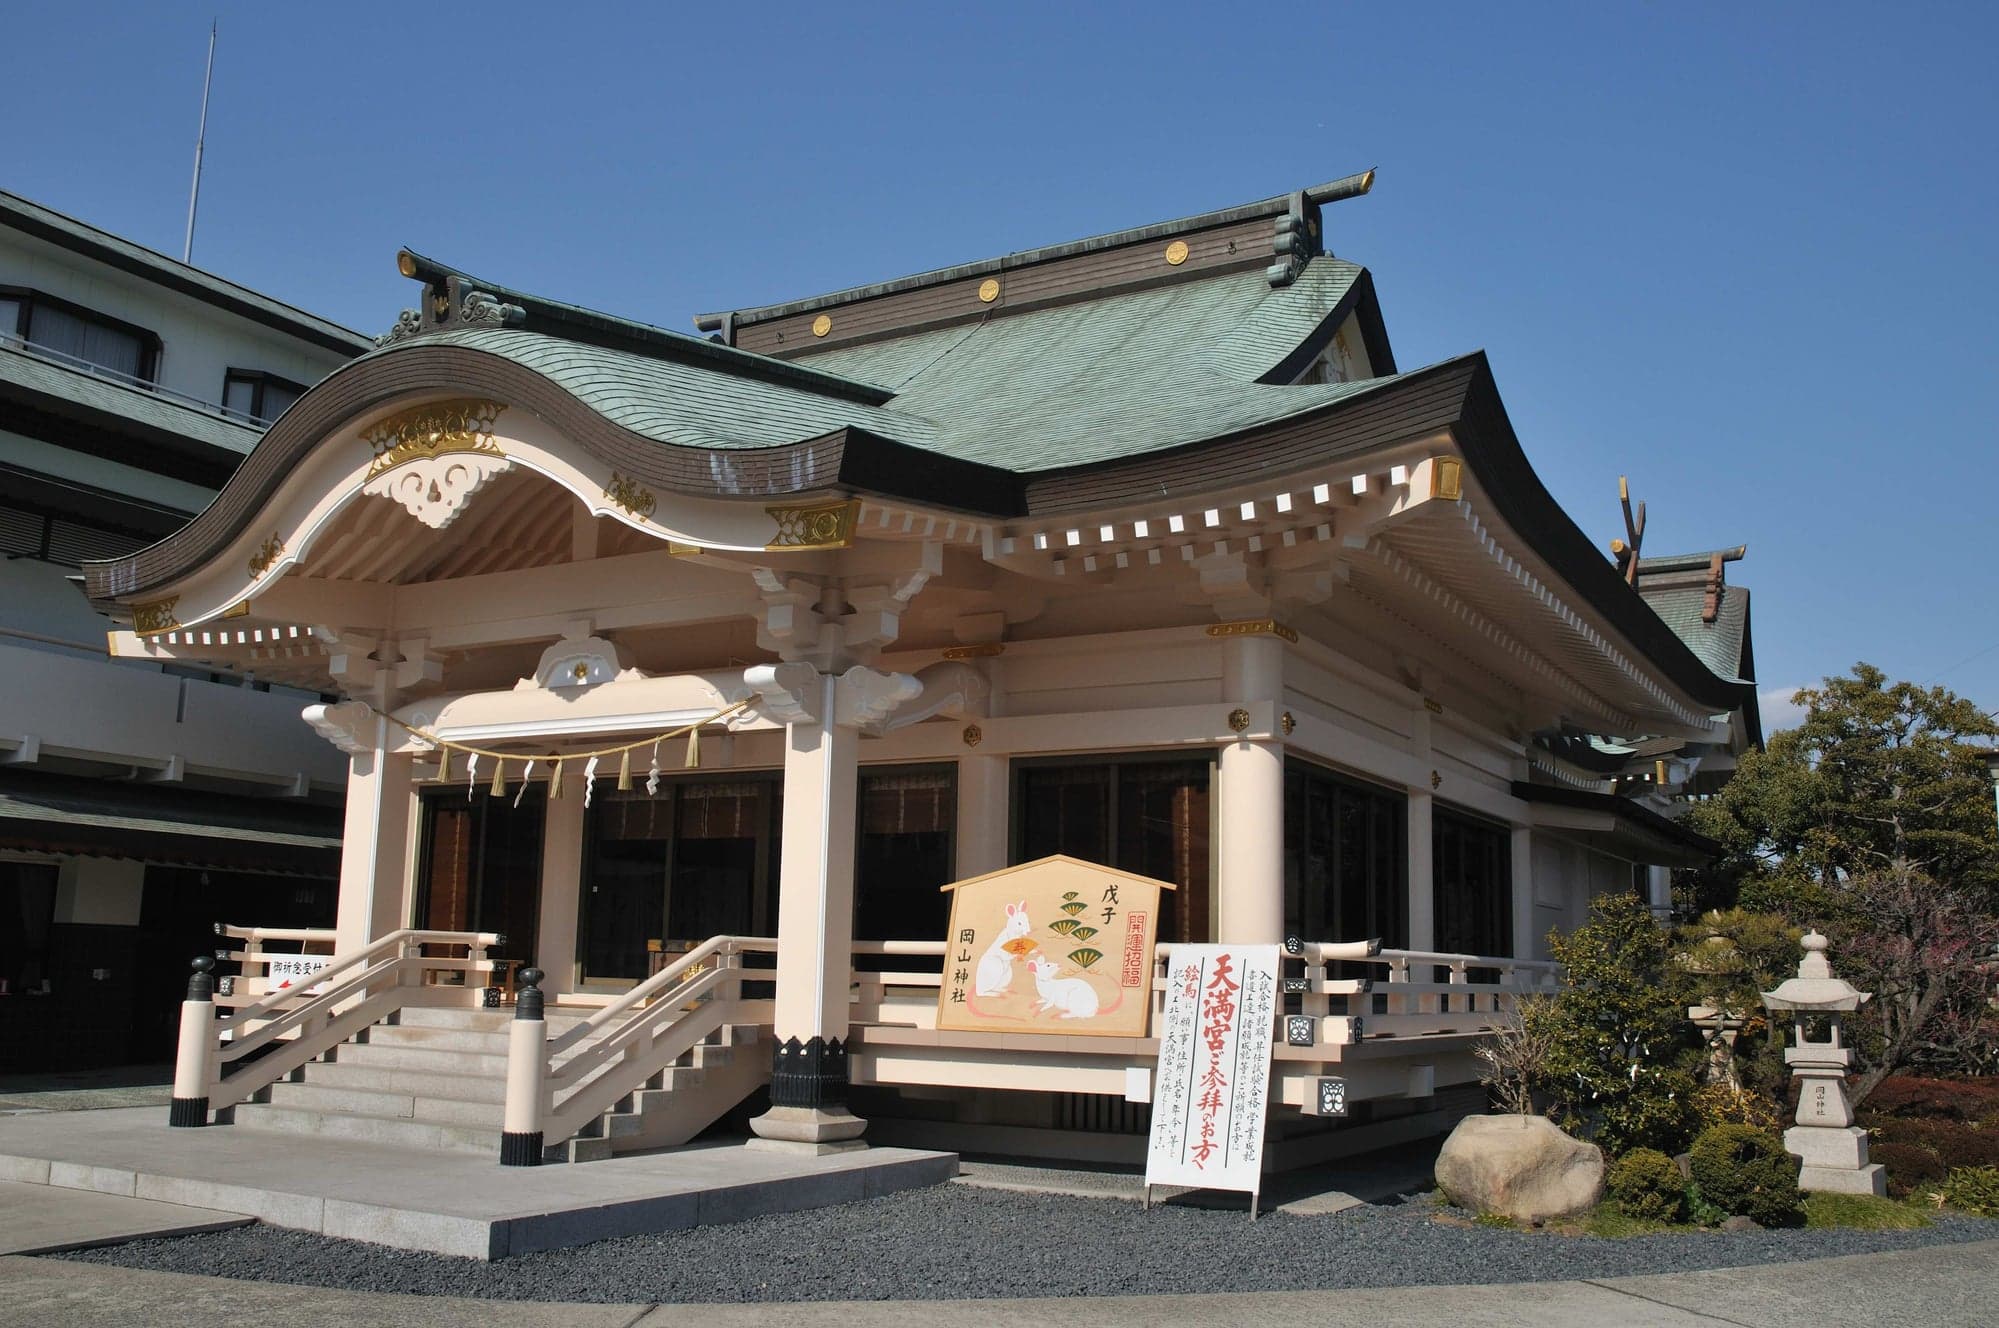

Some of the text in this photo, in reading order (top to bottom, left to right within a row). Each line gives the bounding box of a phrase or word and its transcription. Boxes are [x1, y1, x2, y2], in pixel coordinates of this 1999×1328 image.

[1101, 885, 1119, 925] 戊子
[950, 929, 975, 1003] 岡山神社
[1122, 915, 1145, 985] 開運招福
[1190, 953, 1240, 1171] 天満宮ご参拝のお方へ
